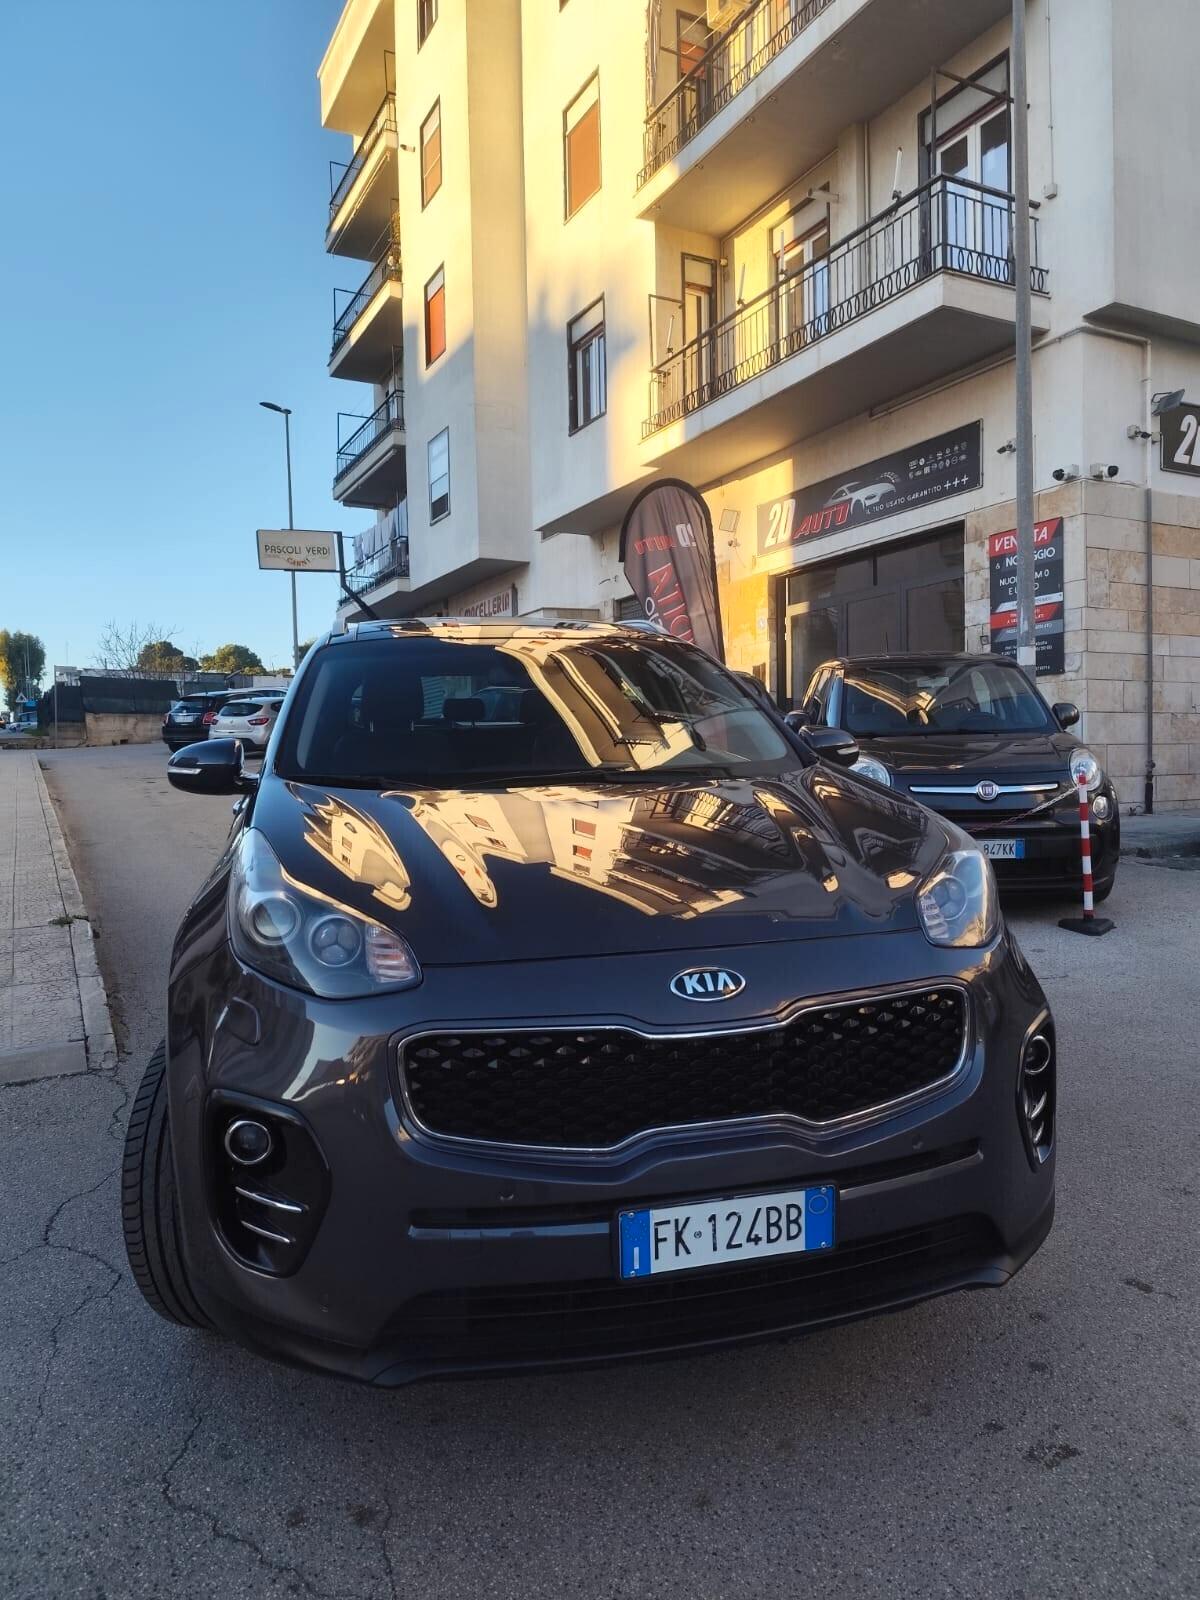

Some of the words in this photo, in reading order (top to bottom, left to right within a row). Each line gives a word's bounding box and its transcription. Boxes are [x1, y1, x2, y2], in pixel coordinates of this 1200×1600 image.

[886, 497, 905, 509] USATO
[906, 484, 942, 501] GARANTITO
[793, 503, 850, 540] AUTO
[264, 544, 302, 555] PASCOLI
[306, 546, 331, 556] VERDI
[682, 971, 736, 996] KIA
